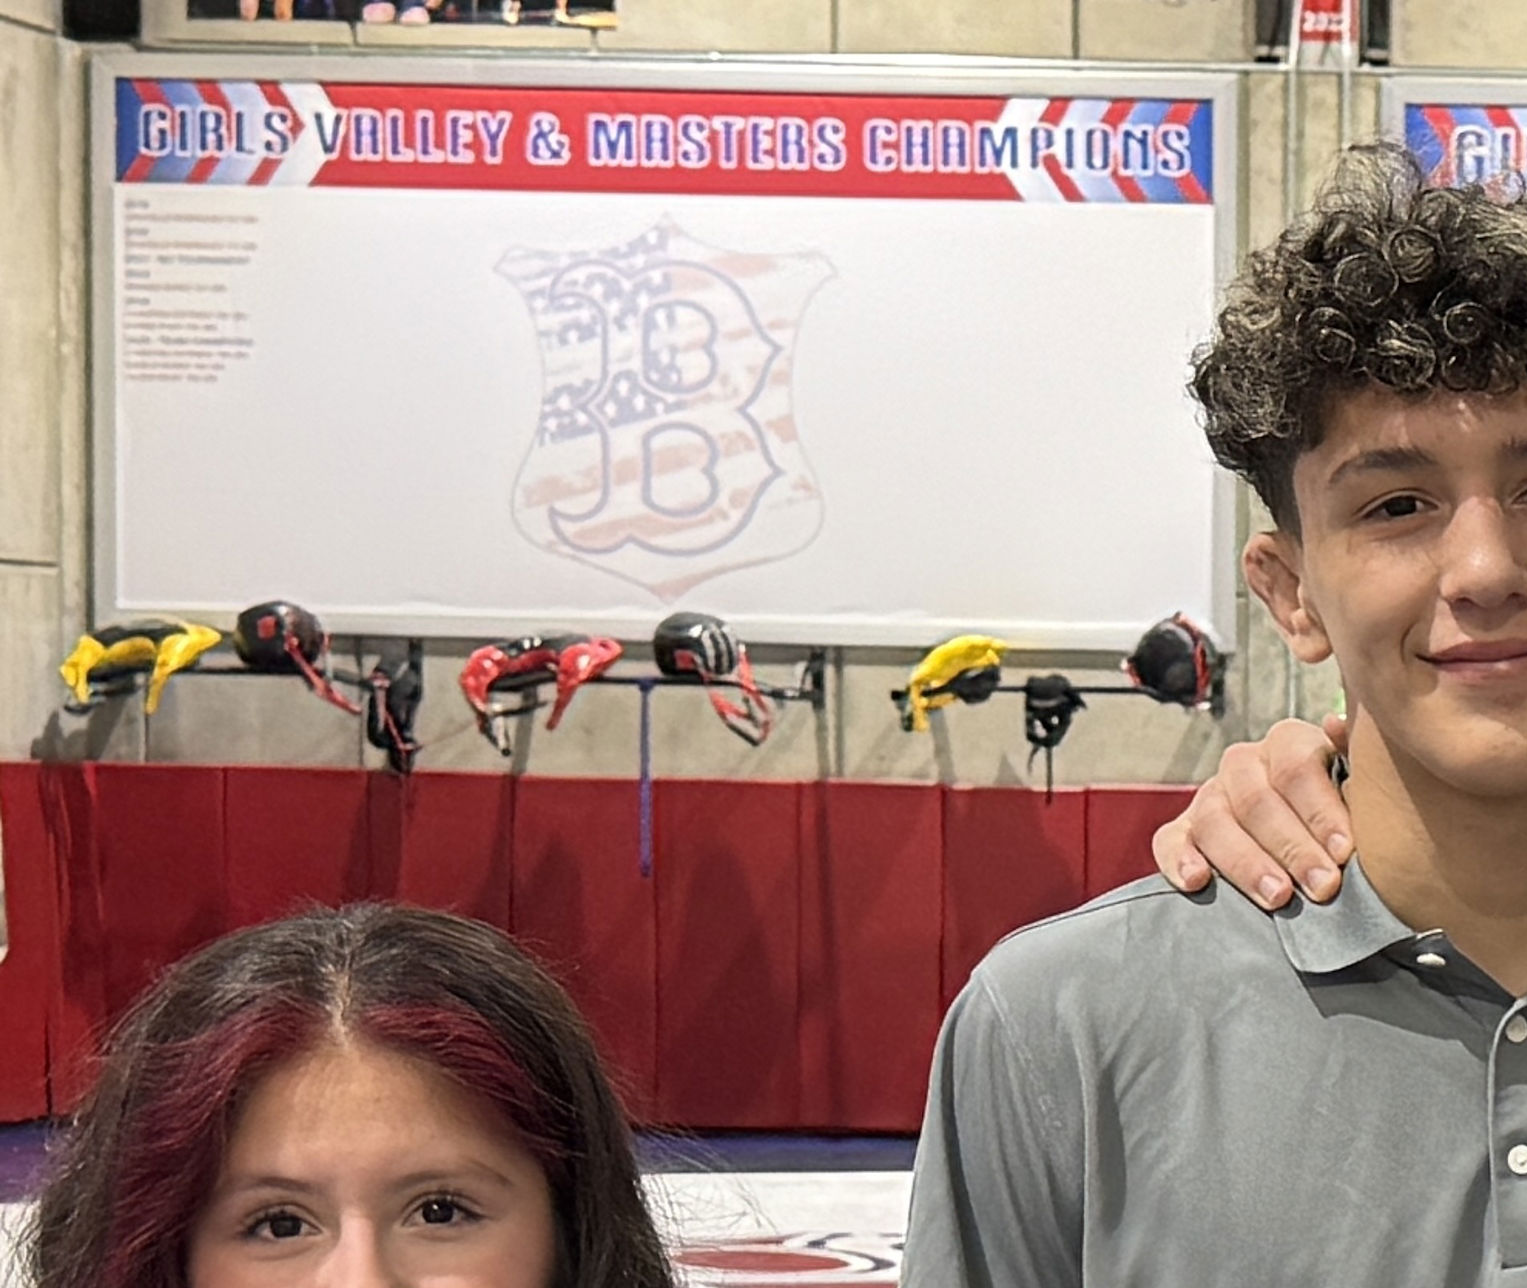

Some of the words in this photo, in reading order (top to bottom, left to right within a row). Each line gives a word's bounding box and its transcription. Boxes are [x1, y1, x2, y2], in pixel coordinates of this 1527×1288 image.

[138, 102, 296, 158] GIRLS
[312, 107, 512, 164] VALLEY
[526, 112, 573, 165] &
[587, 113, 847, 173] MASTERS
[863, 120, 1194, 178] CHAMPIONS
[547, 258, 785, 557] B
